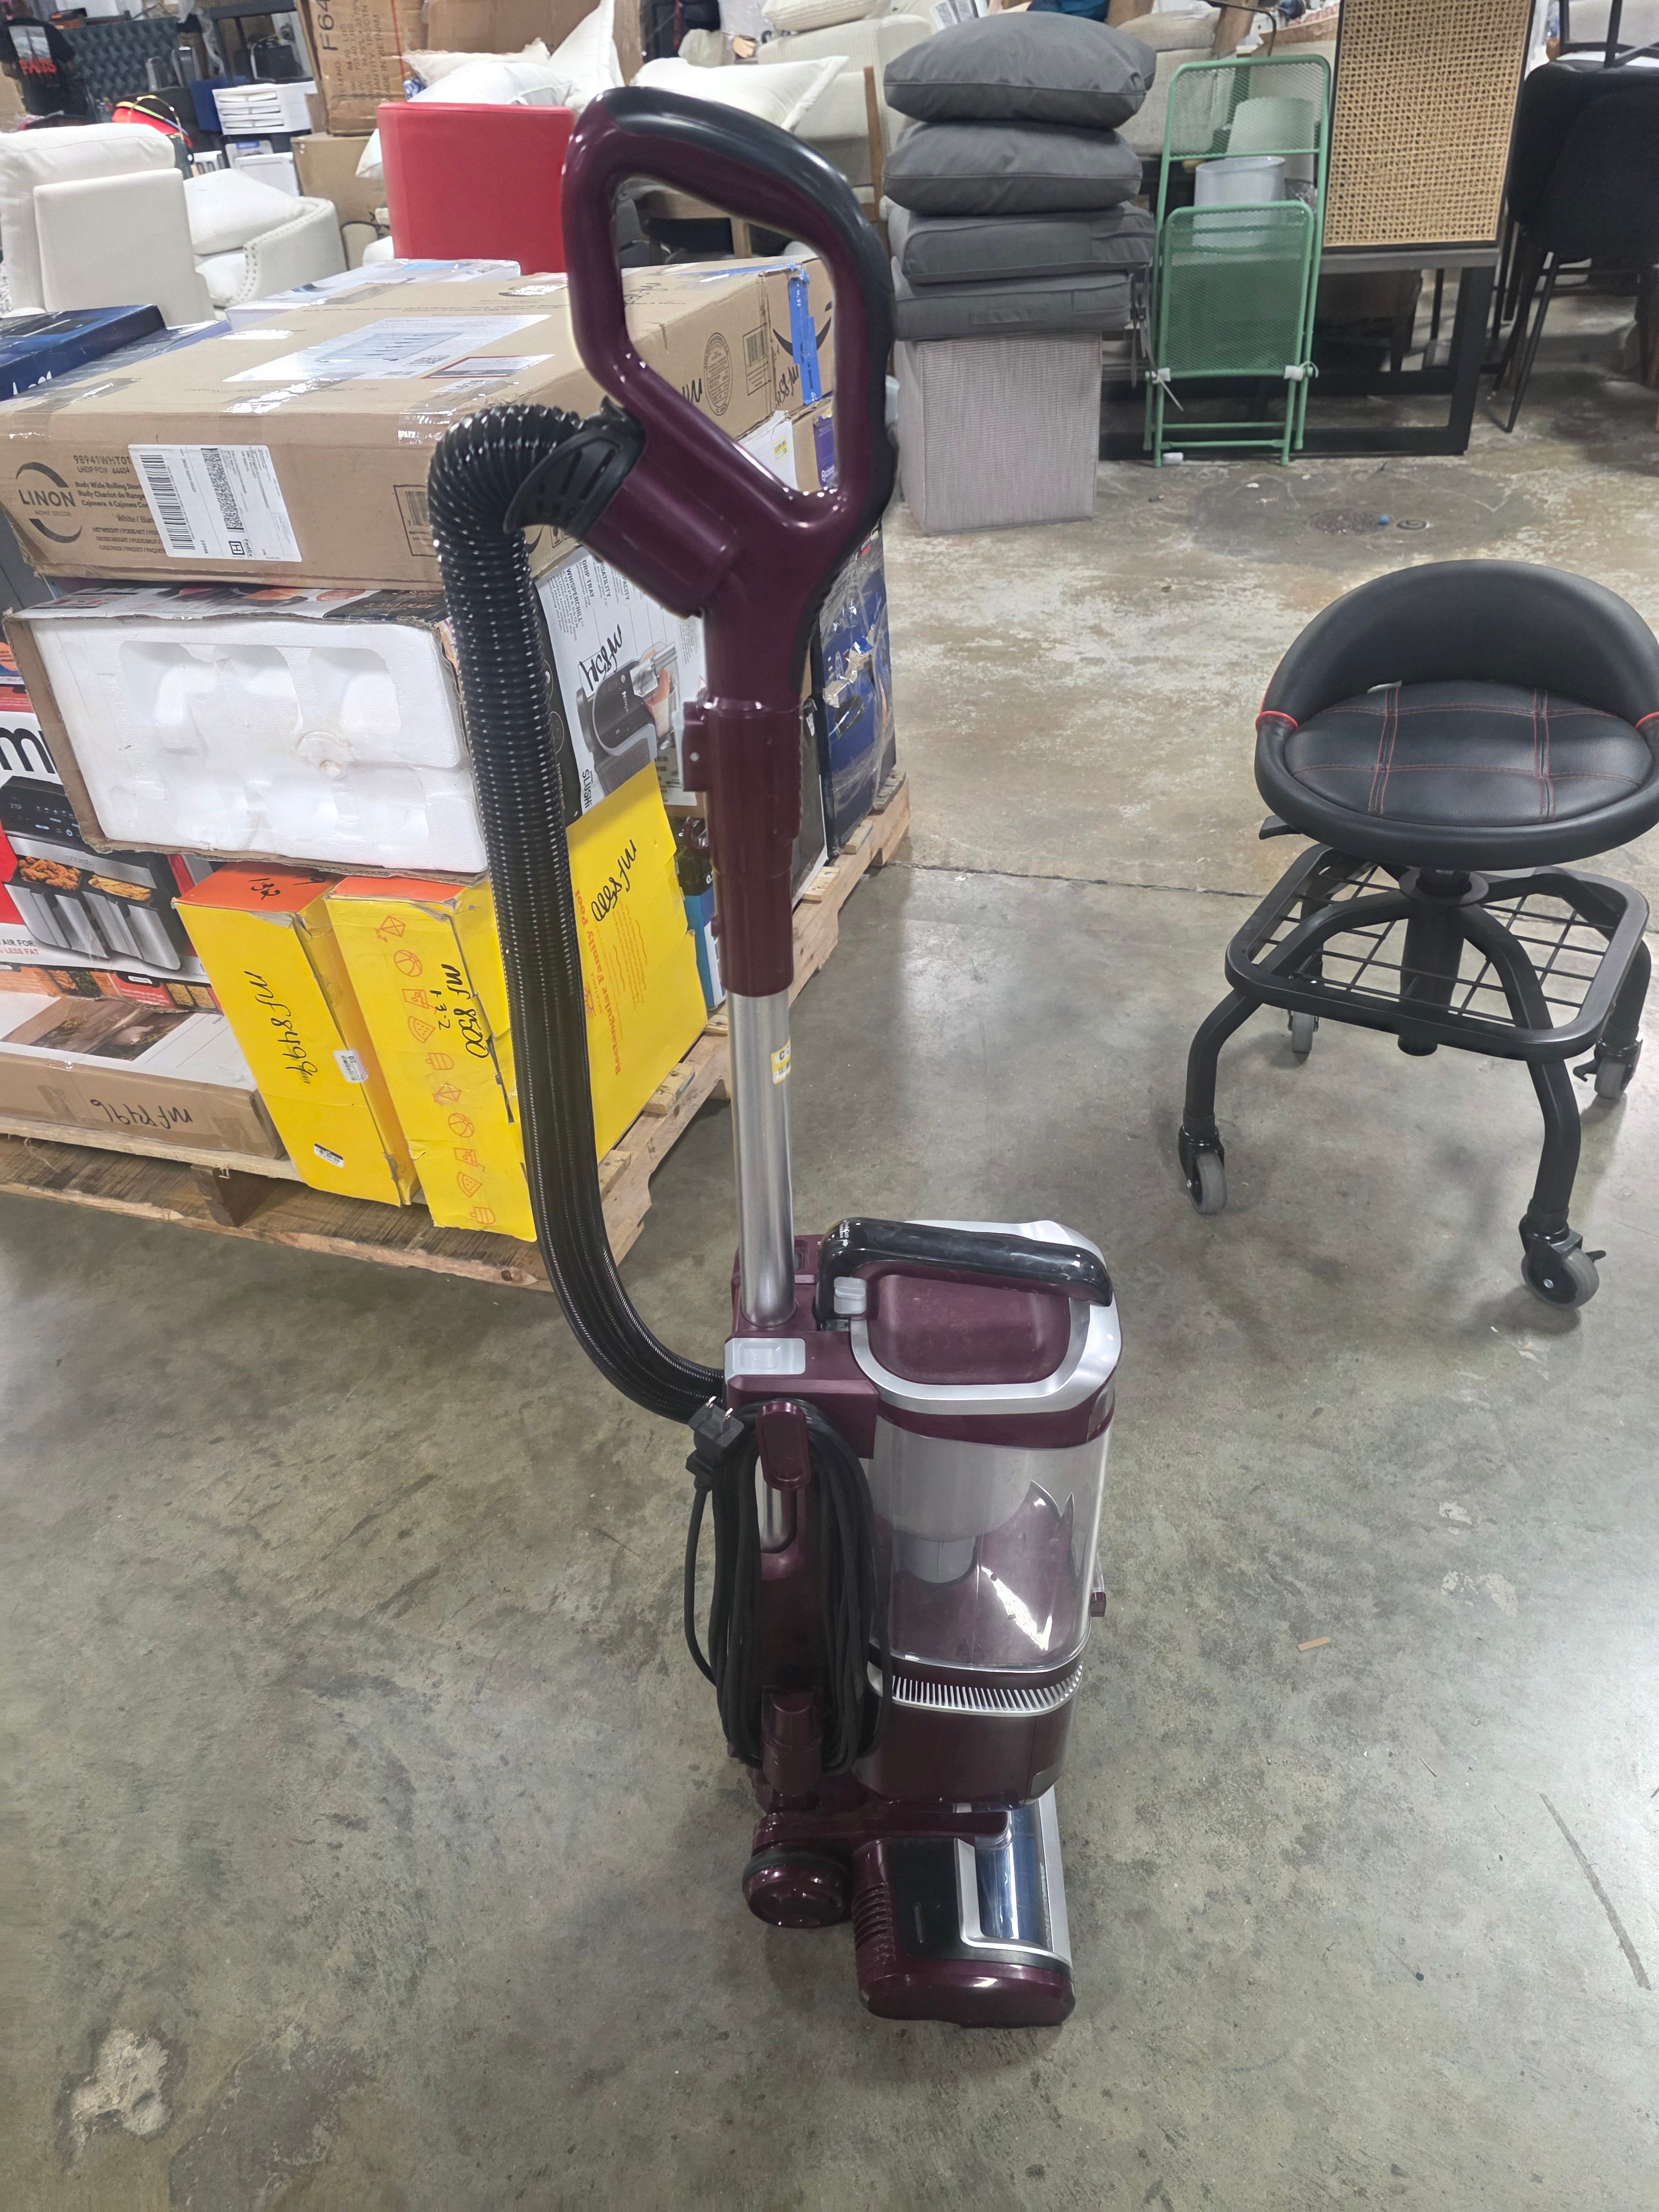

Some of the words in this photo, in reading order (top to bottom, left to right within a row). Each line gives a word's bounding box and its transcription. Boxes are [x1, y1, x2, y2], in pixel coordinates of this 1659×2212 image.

[78, 490, 93, 498] Rudy
[94, 491, 117, 499] Chariot
[106, 482, 126, 491] Rolling
[18, 489, 76, 507] LINON
[81, 499, 107, 508] Cajonera
[114, 500, 137, 509] Cajones
[116, 513, 135, 523] White
[243, 539, 252, 557] FedEx
[587, 578, 595, 597] TRAY
[563, 571, 578, 628] COMPRESSOR
[560, 597, 569, 633] temperature
[575, 889, 589, 927] Pool
[587, 930, 604, 985] Family
[591, 972, 603, 1014] INFLATABLE
[602, 987, 621, 1076] Rectangular
